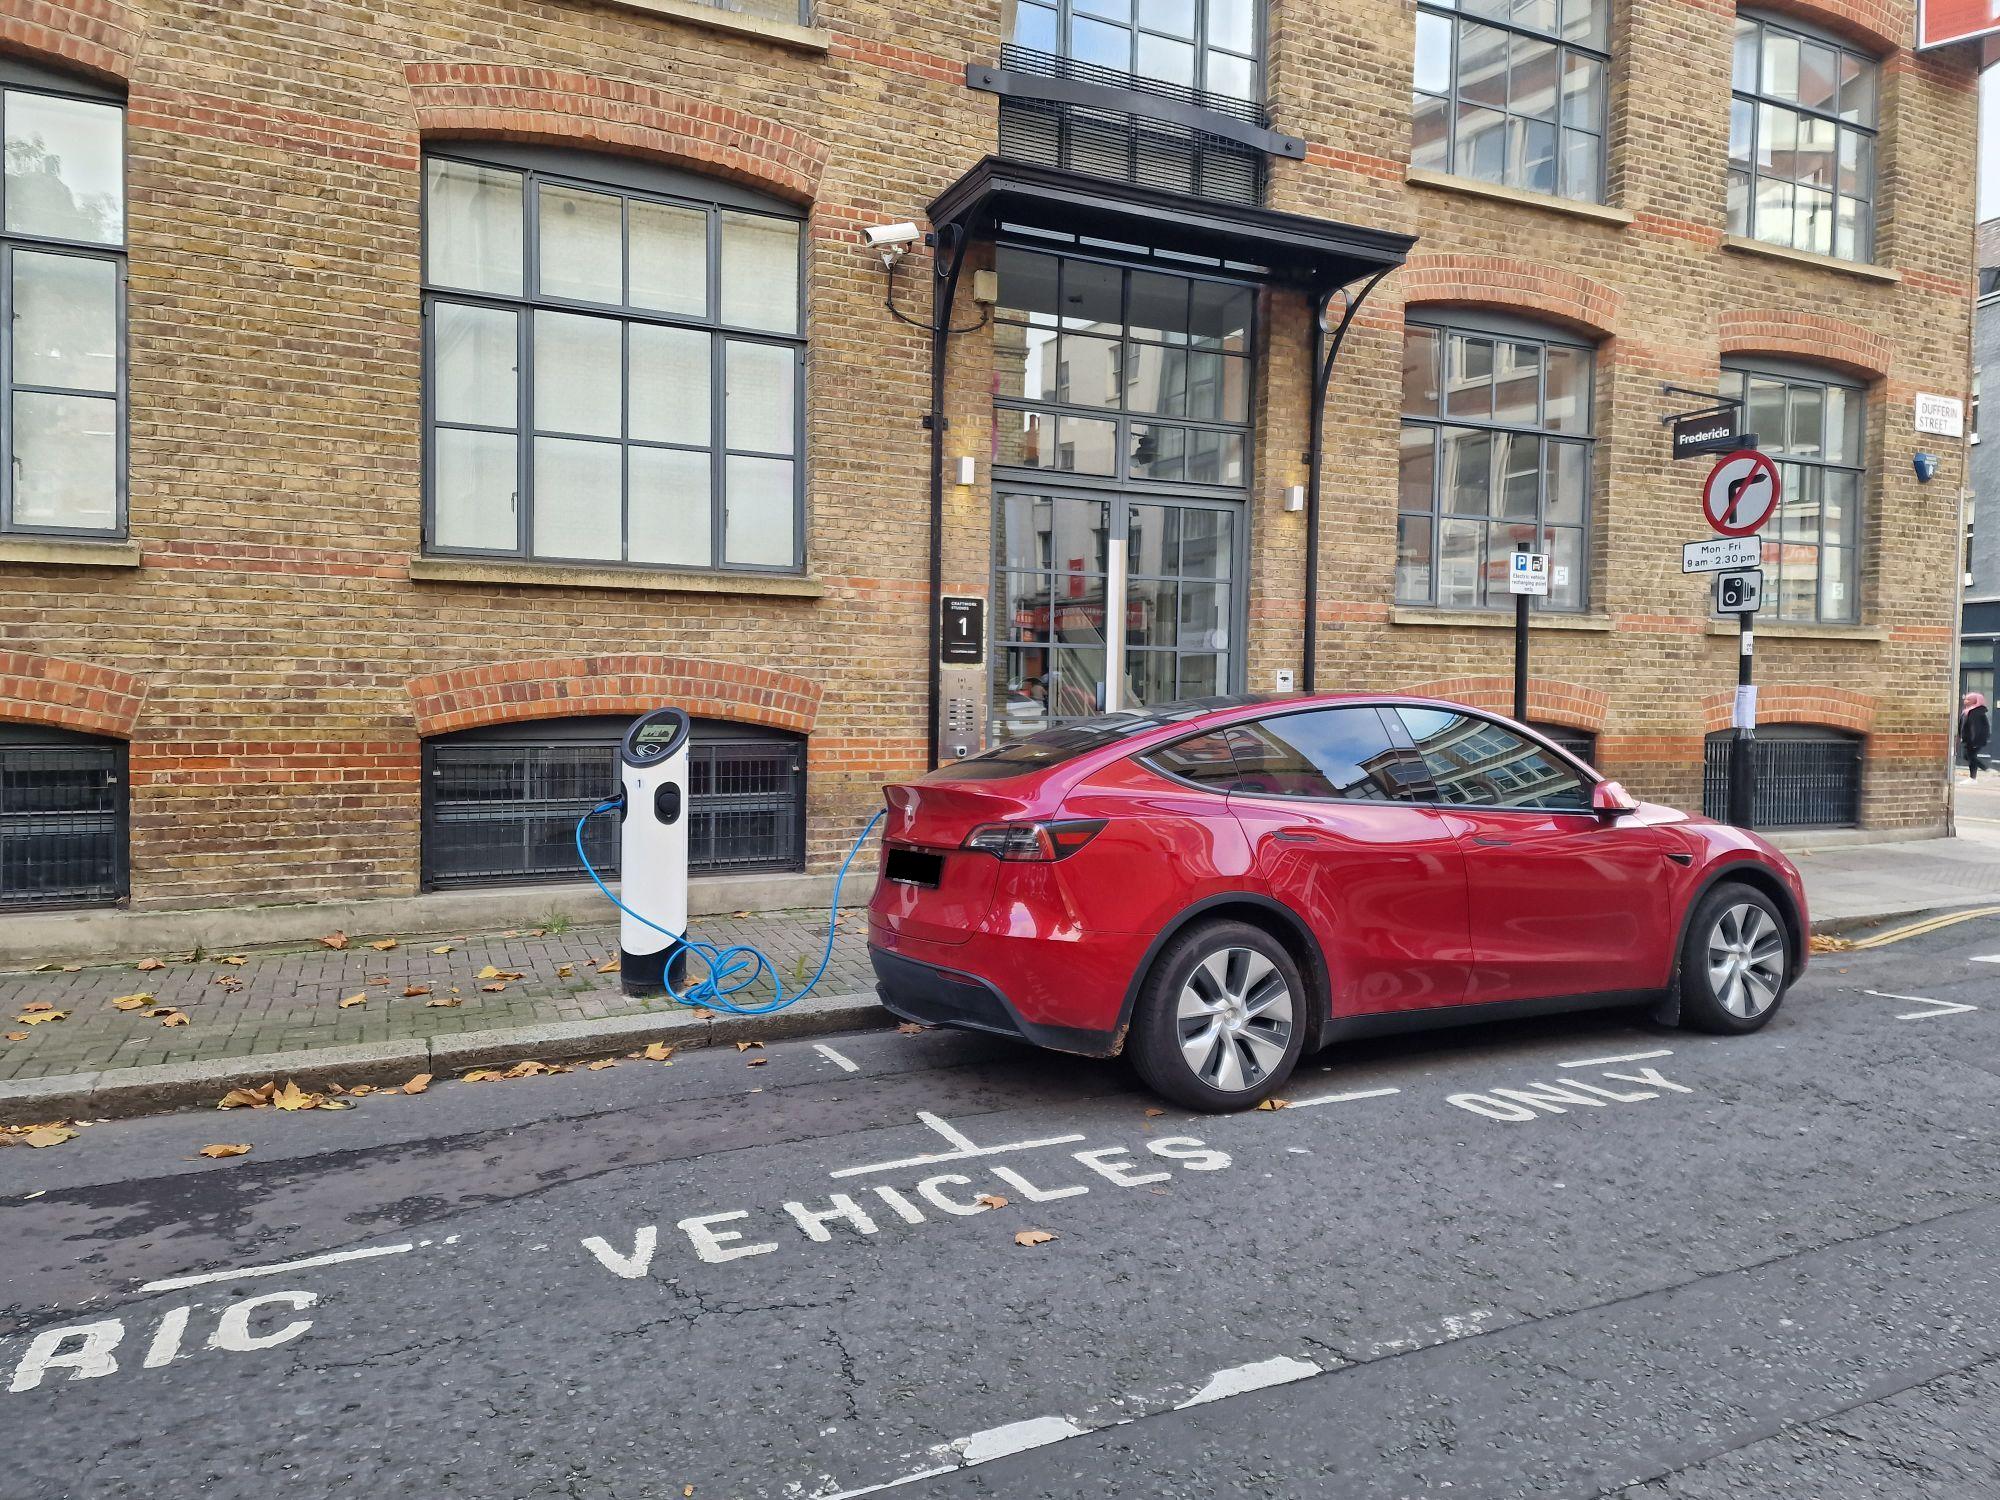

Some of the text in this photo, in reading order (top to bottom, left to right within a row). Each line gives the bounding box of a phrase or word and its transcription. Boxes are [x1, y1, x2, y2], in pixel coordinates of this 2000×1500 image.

[1921, 402, 1958, 418] DUFFERIN
[1919, 416, 1948, 430] STREET
[1679, 427, 1730, 445] Fredericia
[1701, 544, 1721, 554] Mon
[1728, 542, 1741, 551] Fri
[1687, 559, 1693, 568] 9
[1694, 559, 1708, 567] am
[1715, 554, 1738, 565] 2.30
[1740, 554, 1756, 565] pm
[958, 617, 967, 636] 1
[1446, 1068, 1694, 1121] ONLY
[580, 1136, 1232, 1279] VEHICLES
